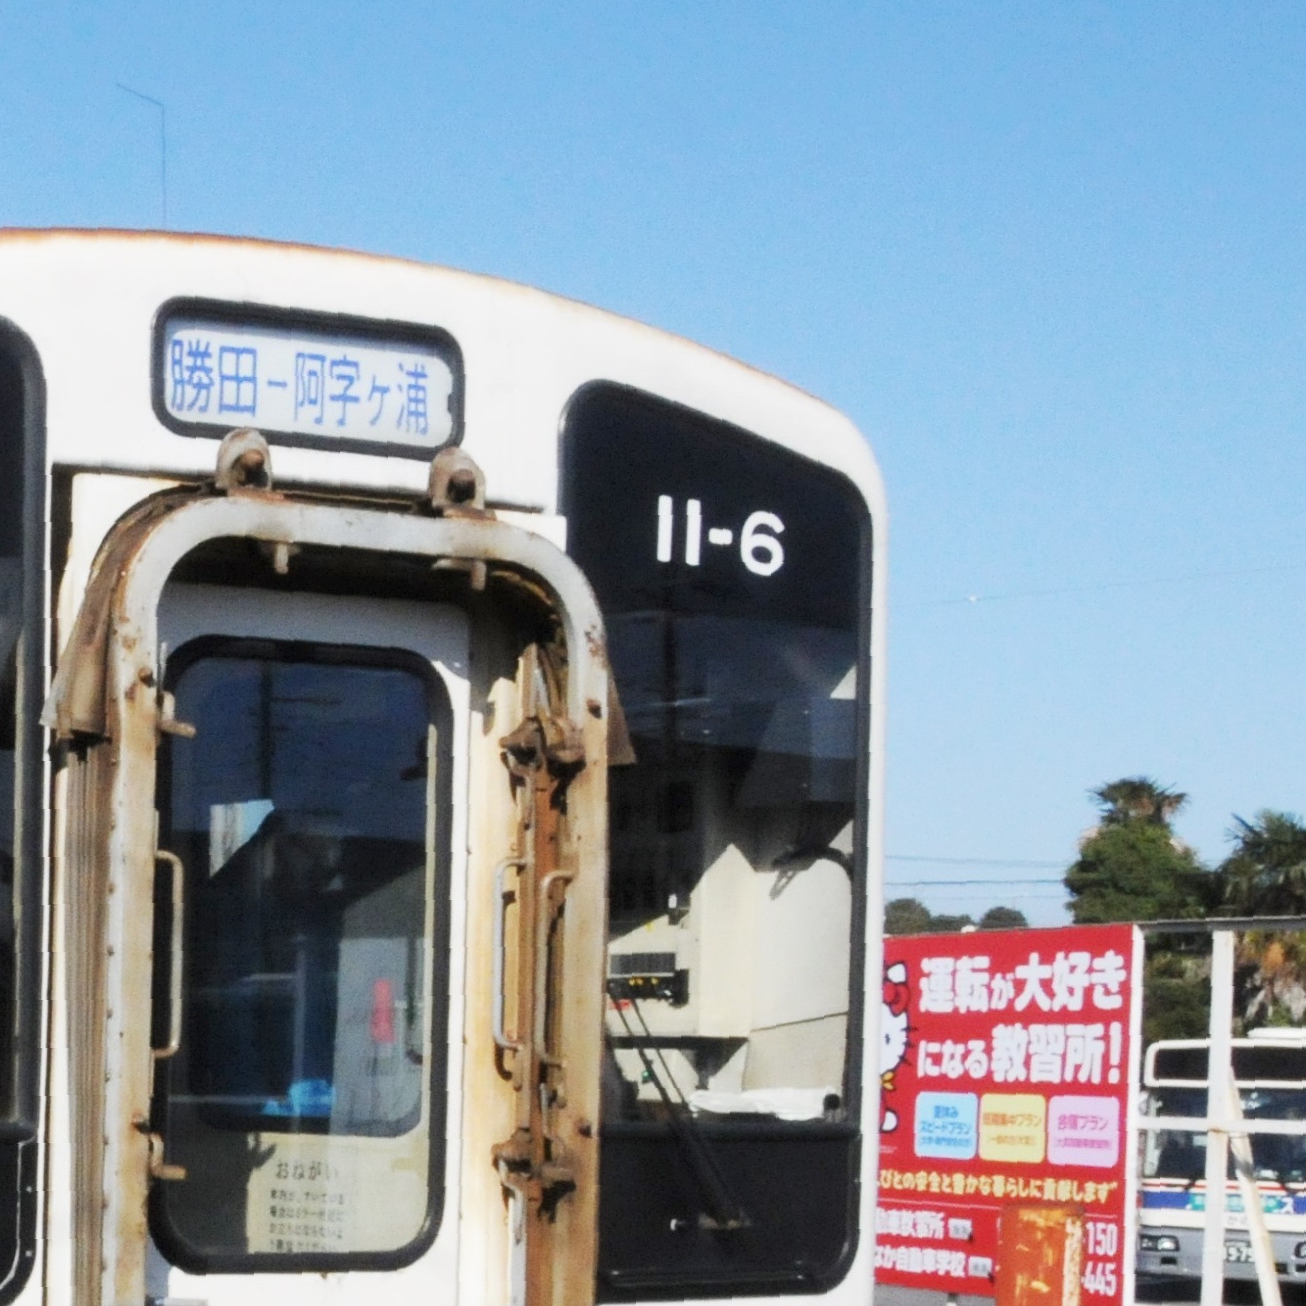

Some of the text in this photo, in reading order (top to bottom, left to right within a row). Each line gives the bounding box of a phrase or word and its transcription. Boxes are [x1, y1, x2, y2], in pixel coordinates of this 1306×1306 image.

[657, 494, 785, 577] 11-6
[919, 950, 1127, 1013] 運転が大好き
[917, 1021, 1123, 1084] になる教習所!
